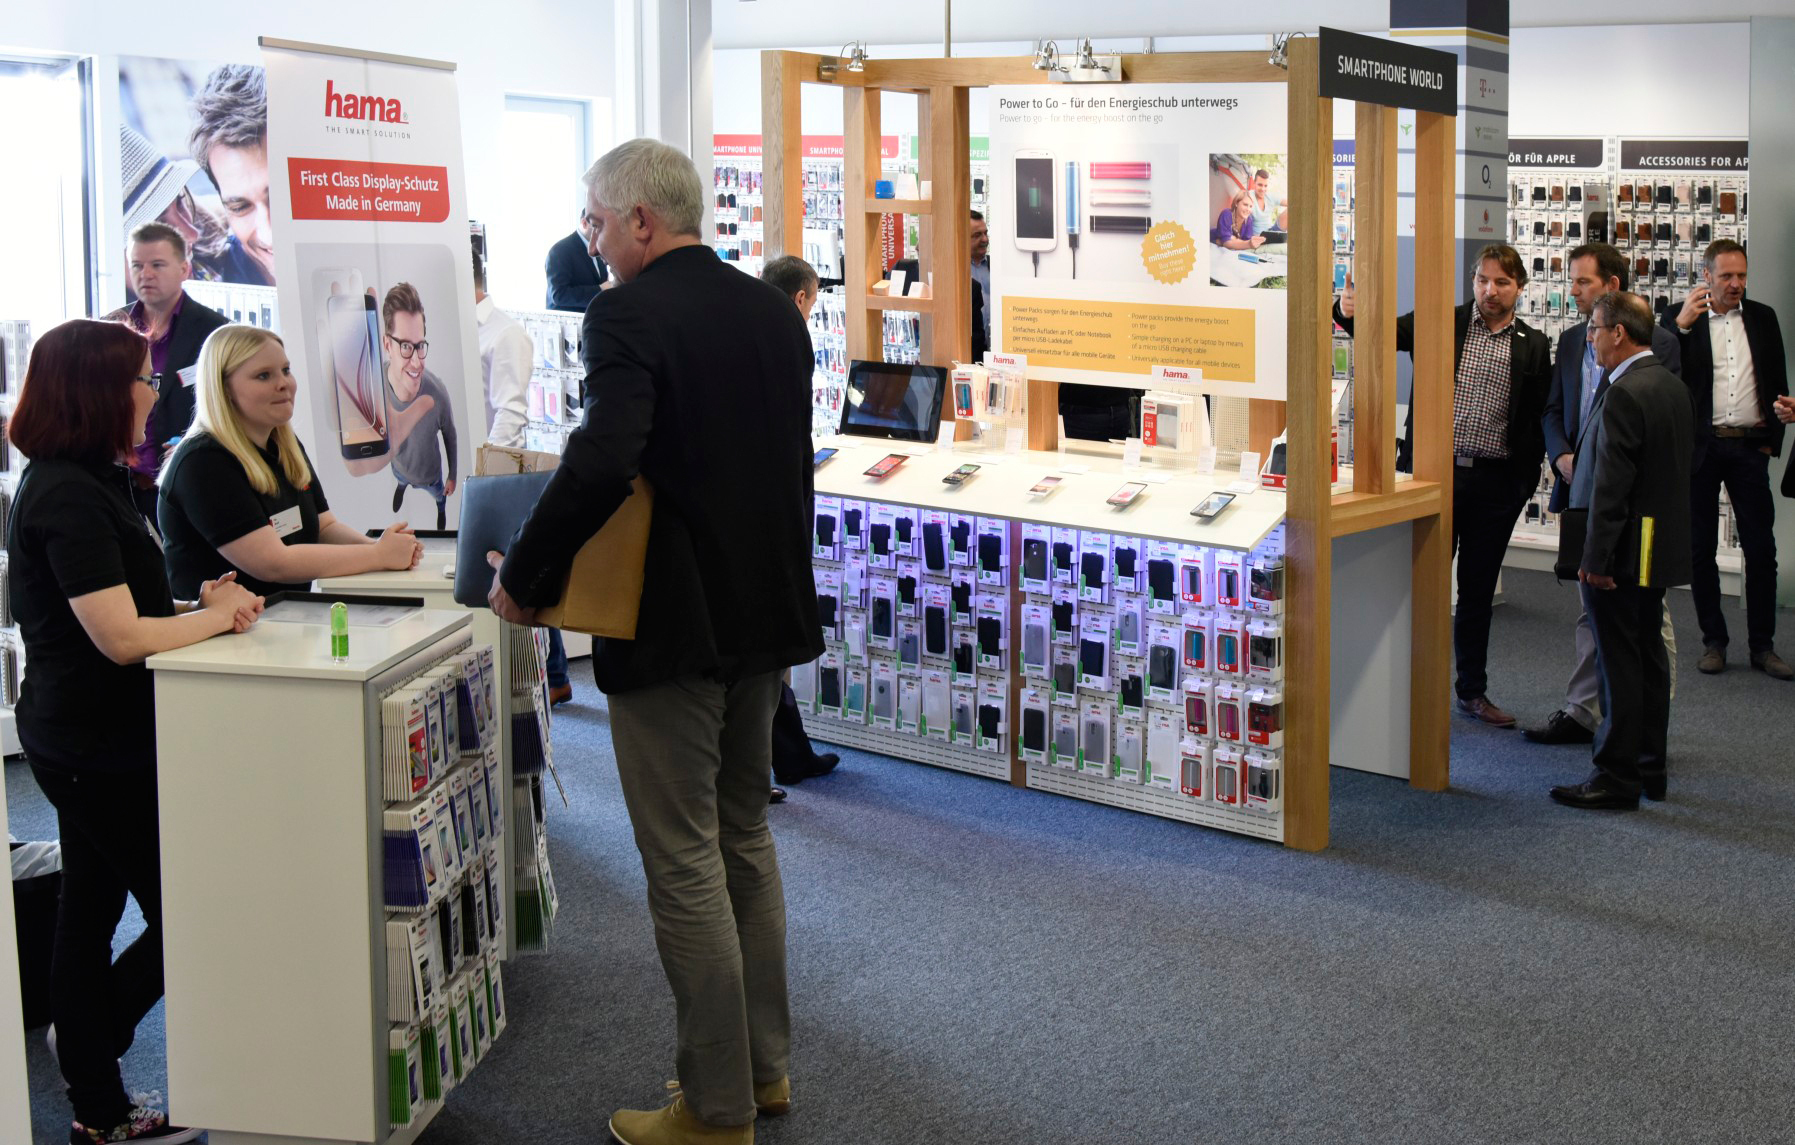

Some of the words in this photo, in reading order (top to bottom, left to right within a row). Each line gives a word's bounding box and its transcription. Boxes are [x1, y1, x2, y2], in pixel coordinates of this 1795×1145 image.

[1338, 55, 1406, 84] SMARTPHONE
[1410, 68, 1442, 90] WORLD
[325, 80, 405, 123] hama
[1000, 98, 1030, 108] Power
[1033, 99, 1042, 108] to
[1046, 98, 1058, 108] Go
[1070, 97, 1084, 108] für
[1088, 98, 1106, 108] den
[1110, 96, 1178, 110] Energieschub
[1182, 97, 1238, 110] unterwegs
[1000, 114, 1021, 122] Power
[1034, 116, 1042, 124] go
[1063, 114, 1074, 122] the
[1077, 116, 1101, 124] energy
[1104, 114, 1124, 122] boost
[1139, 114, 1151, 122] the
[1154, 115, 1163, 124] go
[374, 130, 410, 139] SOLUTION
[1525, 152, 1542, 163] FÜR
[1546, 154, 1576, 163] APPLE
[1639, 156, 1706, 166] ACCESSORIES
[1711, 157, 1731, 166] FOR
[300, 170, 328, 187] First
[332, 172, 359, 188] Class
[362, 174, 439, 193] Display-Schutz
[326, 195, 358, 210] Made
[362, 196, 371, 211] in
[375, 197, 421, 216] Germany
[1155, 232, 1175, 242] Gleich
[1148, 245, 1189, 262] mitnehmen!
[1080, 310, 1112, 318] Energieschub
[993, 355, 1015, 365] hama
[1163, 368, 1188, 379] hama
